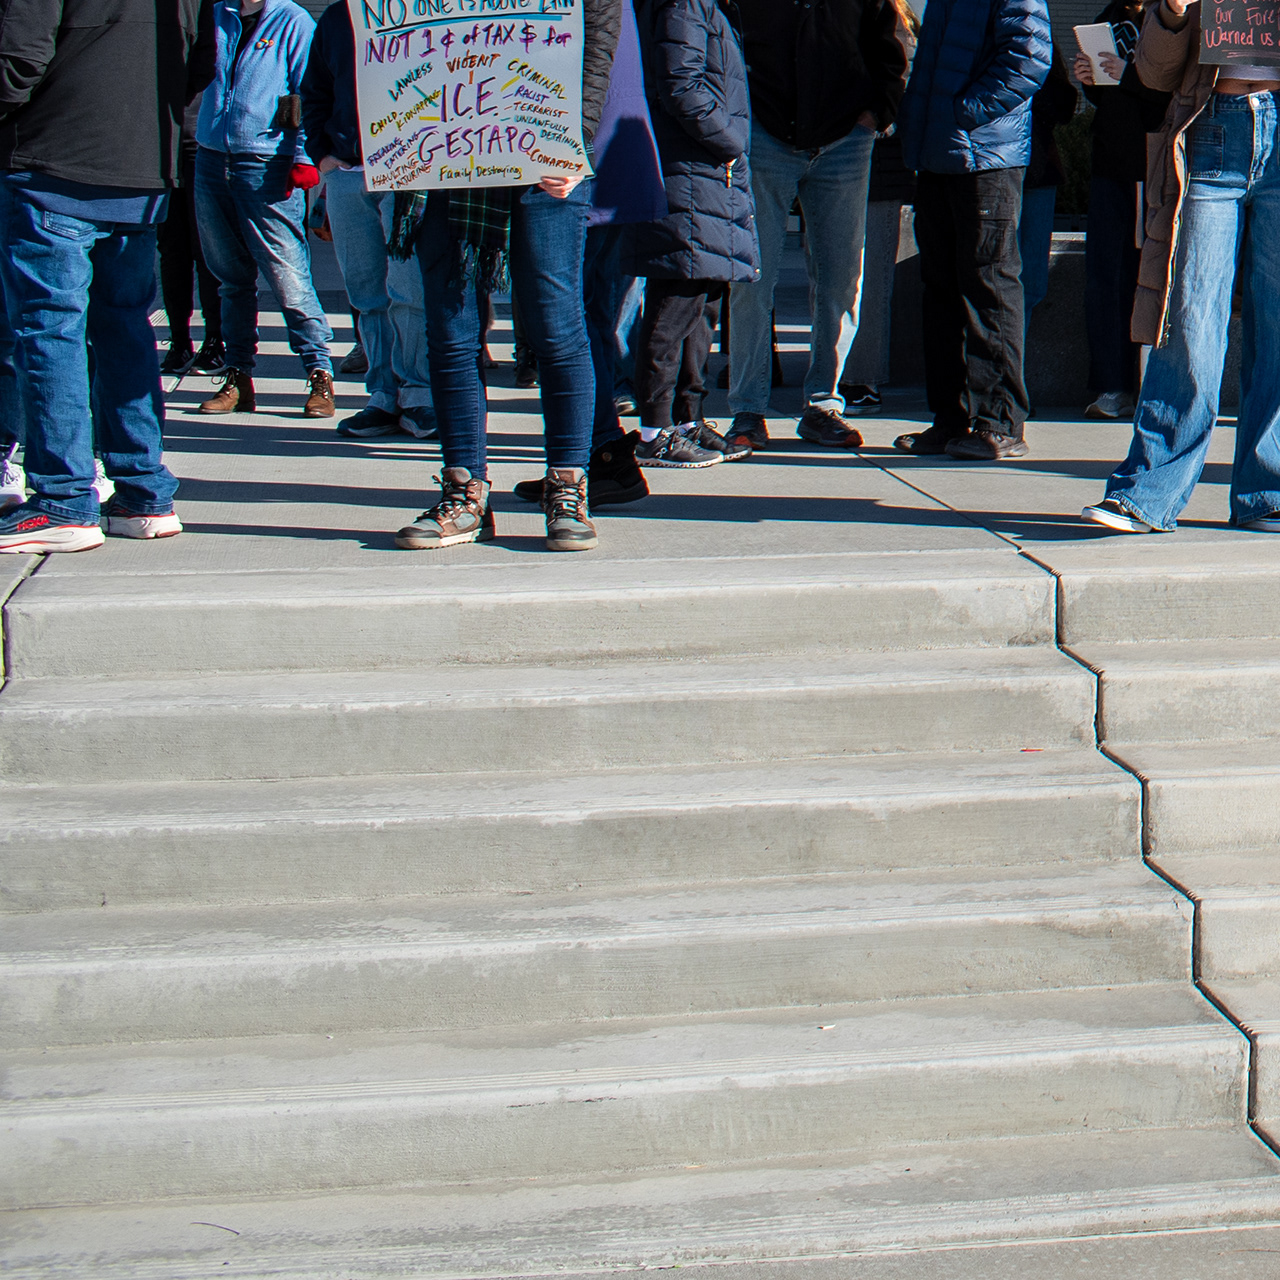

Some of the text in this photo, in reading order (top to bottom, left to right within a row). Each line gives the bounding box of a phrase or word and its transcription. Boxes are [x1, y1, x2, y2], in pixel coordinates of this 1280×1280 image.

[364, 28, 417, 67] NOT
[462, 22, 481, 48] of
[481, 22, 516, 48] TAX
[542, 25, 573, 48] for
[1205, 26, 1255, 49] Warned
[388, 61, 434, 102] LAWLESS
[507, 58, 568, 101] CRIMINAL
[514, 84, 551, 106] RACIST
[418, 123, 537, 165] GESTAPO
